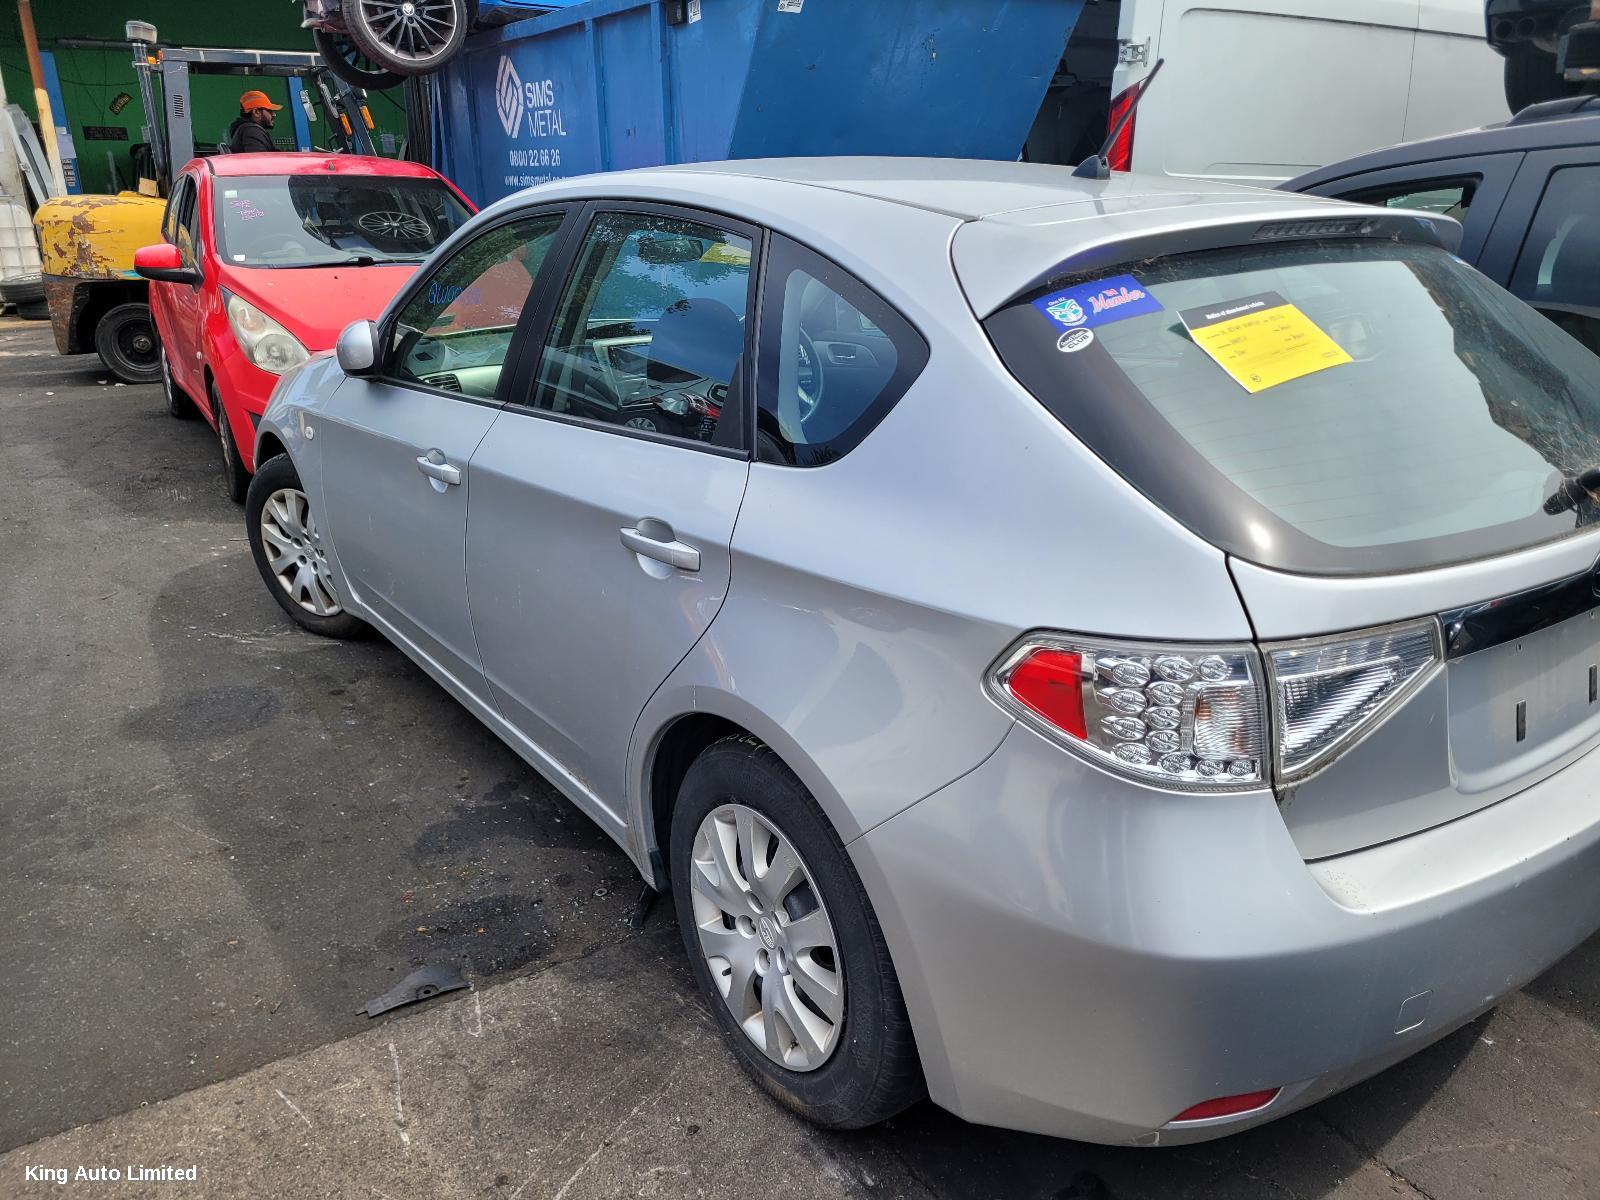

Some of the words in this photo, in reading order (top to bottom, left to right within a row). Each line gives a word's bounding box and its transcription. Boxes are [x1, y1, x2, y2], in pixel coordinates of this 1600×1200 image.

[525, 79, 554, 108] SIMS
[528, 108, 567, 137] METAL
[509, 149, 528, 167] 0800
[529, 149, 539, 166] 22
[540, 149, 550, 166] 66
[551, 148, 561, 166] 26
[1088, 286, 1146, 314] Member
[1067, 333, 1089, 349] CLUB
